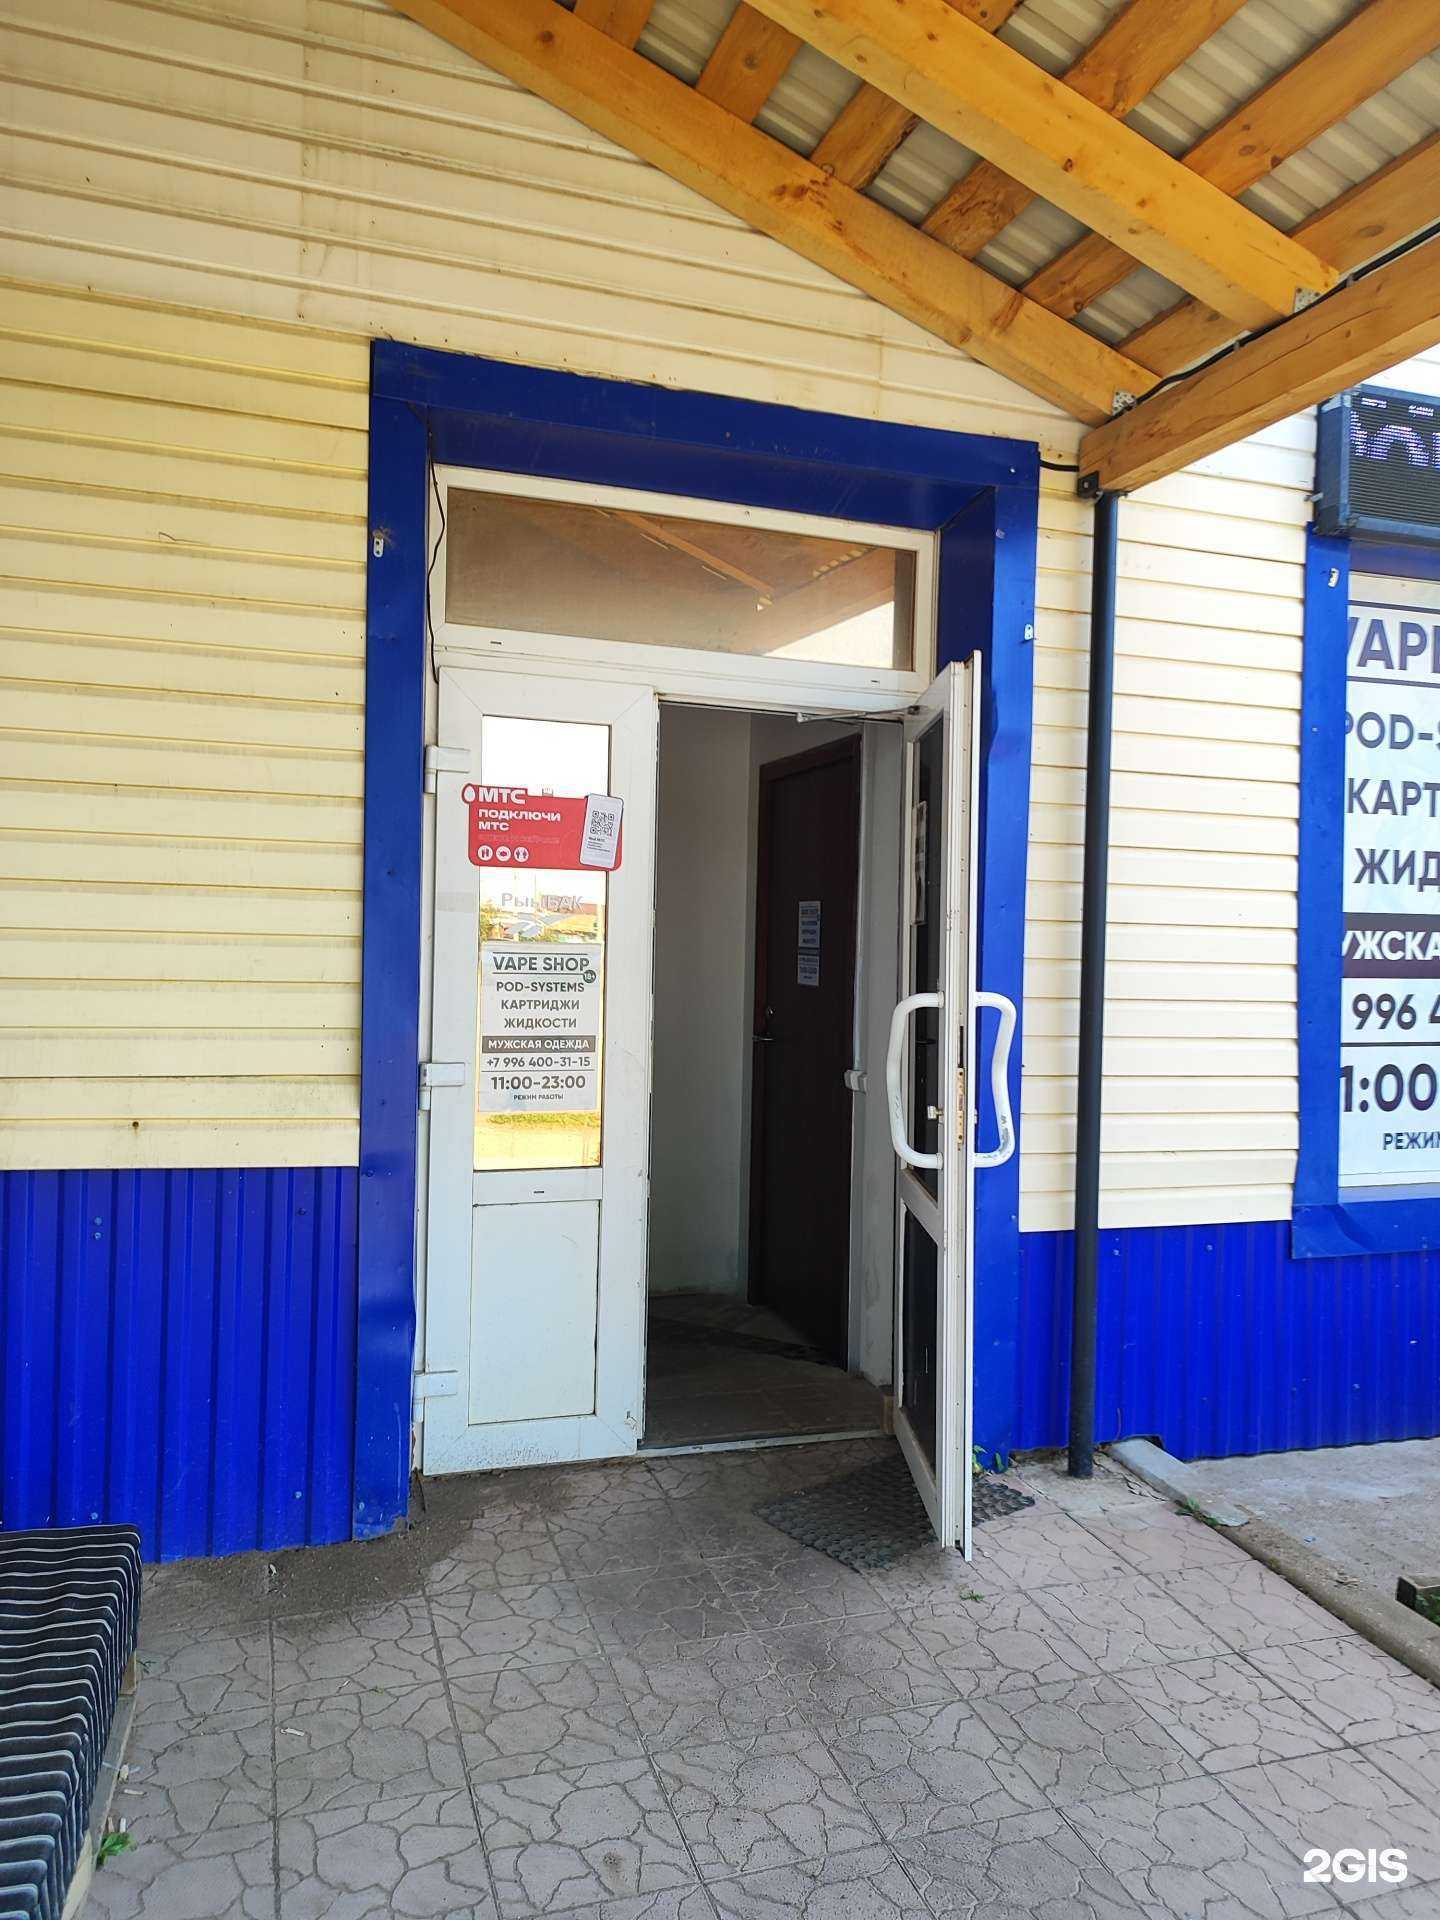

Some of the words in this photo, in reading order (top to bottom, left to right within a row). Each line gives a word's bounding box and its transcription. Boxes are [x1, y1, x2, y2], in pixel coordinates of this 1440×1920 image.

[1345, 711, 1440, 750] OD-
[479, 787, 526, 805] МТС
[1348, 777, 1440, 818] КАРТ
[478, 808, 561, 822] ПОДКЛЮЧИ
[478, 821, 510, 831] МТС
[1354, 848, 1440, 892] ЖИД
[493, 956, 537, 971] VAPE
[542, 957, 590, 971] SHOP
[496, 981, 585, 993] POD-SYSTEMS
[501, 999, 580, 1011] КАРТРИДЖИ
[1352, 993, 1417, 1031] 996
[504, 1018, 577, 1030] ЖИДКОСТИ
[488, 1039, 542, 1049] МУЖСКАЯ
[544, 1039, 590, 1051] ОДЕЖДА
[487, 1057, 500, 1068] +7
[503, 1057, 526, 1068] 996
[528, 1056, 591, 1067] 400-31-15
[490, 1075, 586, 1089] 11:00-23:00
